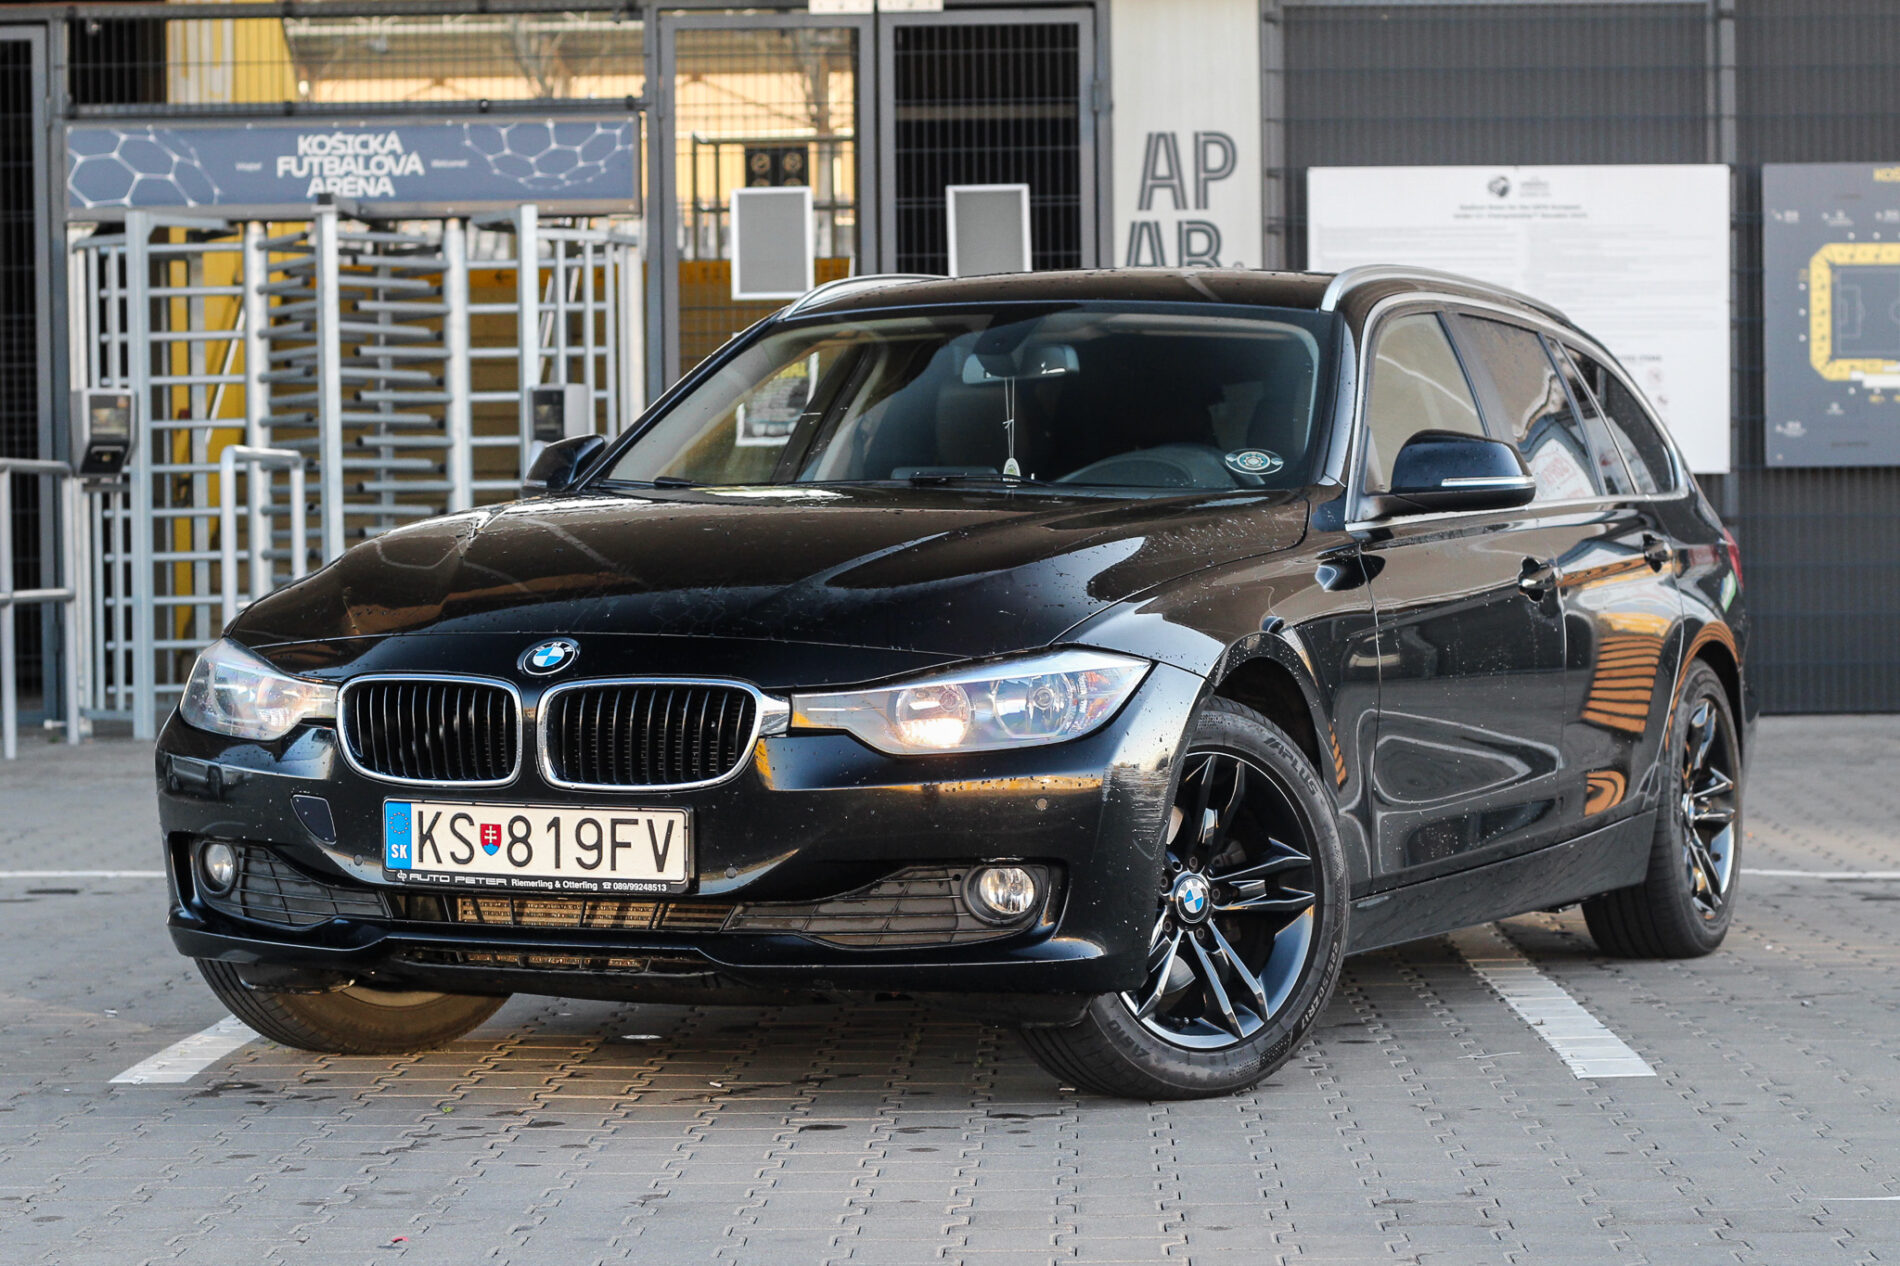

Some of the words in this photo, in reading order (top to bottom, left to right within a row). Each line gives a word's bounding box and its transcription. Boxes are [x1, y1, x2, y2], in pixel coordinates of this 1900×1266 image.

[1137, 131, 1237, 211] AP
[390, 843, 408, 860] SK
[417, 811, 475, 865] KS
[506, 815, 675, 873] 819FV
[410, 873, 450, 883] AUTO
[454, 875, 507, 886] PETER
[555, 880, 561, 889] &
